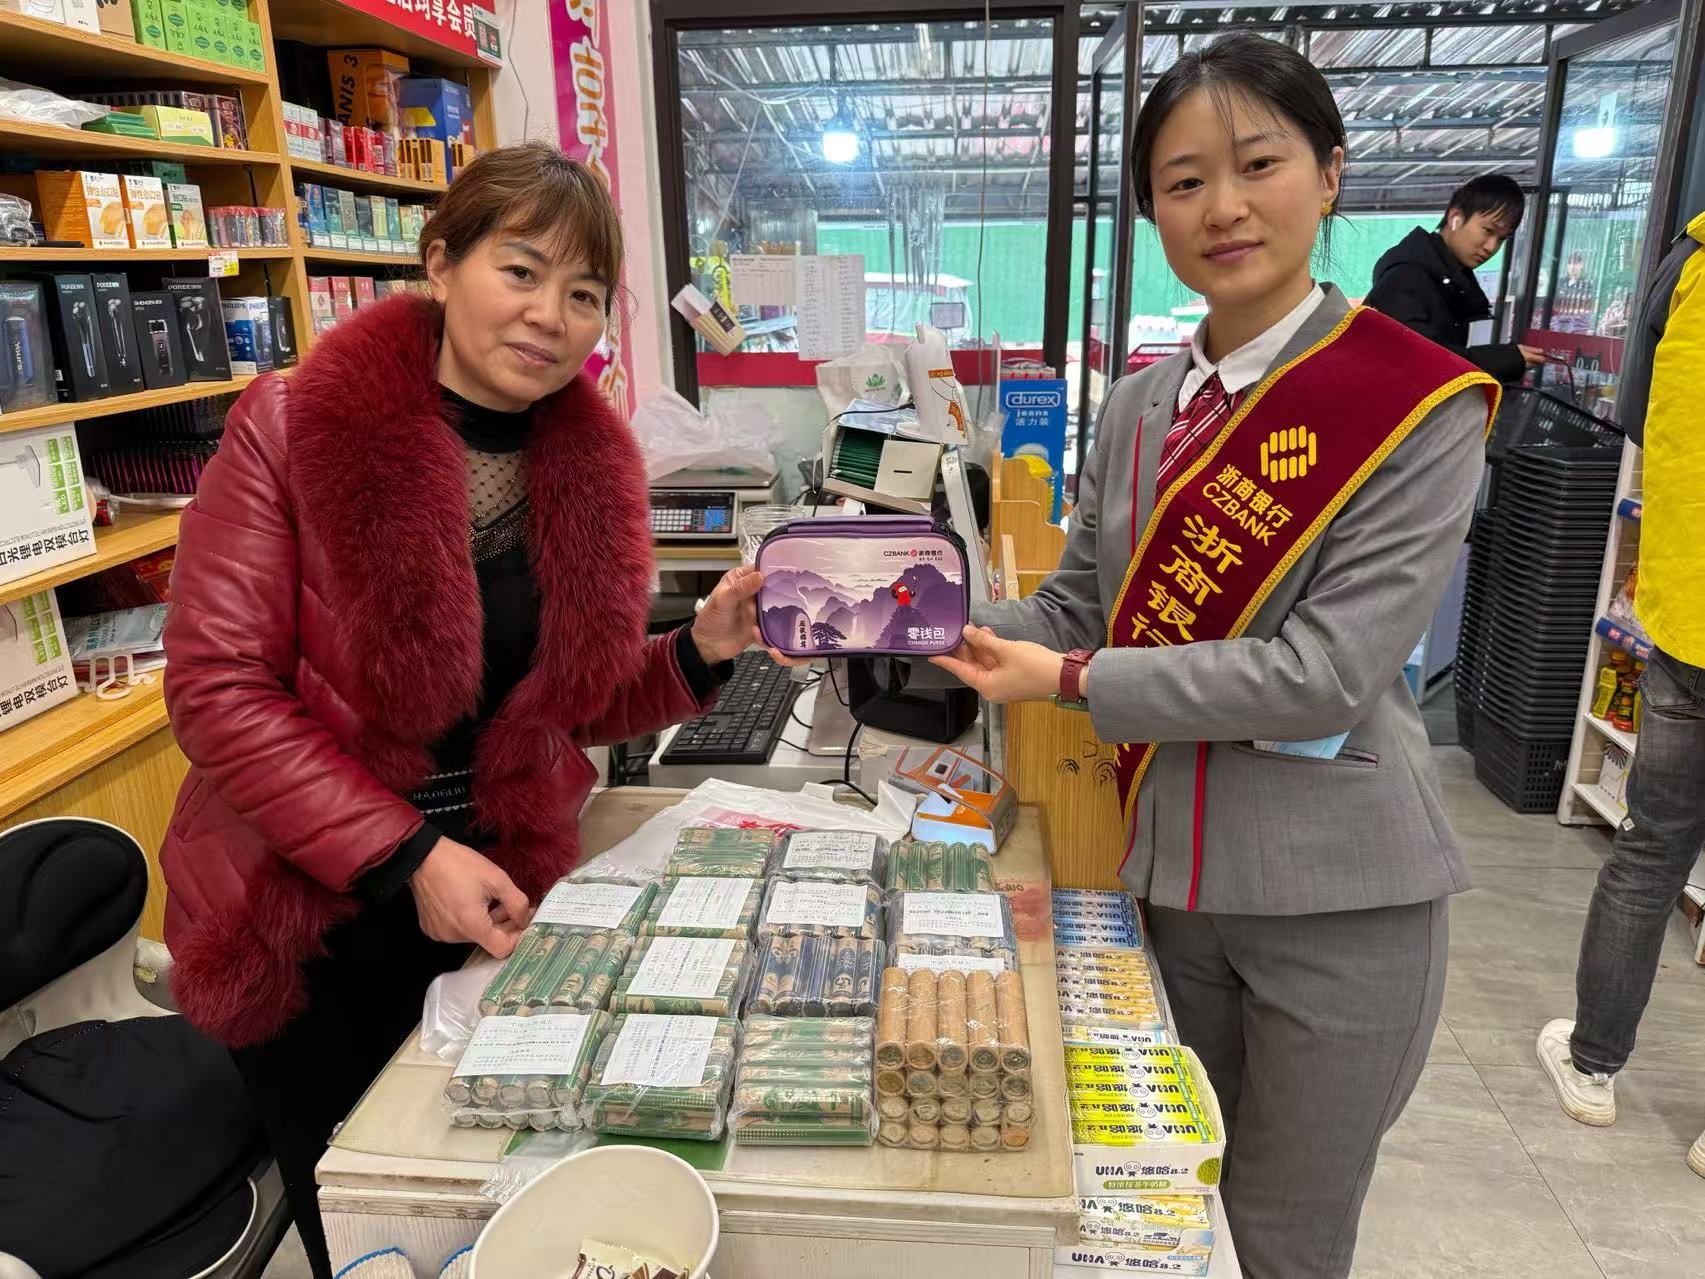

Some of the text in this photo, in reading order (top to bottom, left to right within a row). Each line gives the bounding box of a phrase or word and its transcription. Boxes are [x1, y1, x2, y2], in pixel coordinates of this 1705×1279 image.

[386, 0, 476, 40] 可享会员
[1012, 393, 1057, 406] durex
[1016, 409, 1048, 417] jeans
[1216, 463, 1293, 529] 浙商银行
[1202, 482, 1277, 547] CZBANK
[907, 627, 945, 640] 零钱包
[0, 675, 69, 717] 锂电双模台灯
[1142, 1065, 1174, 1074] UHA
[1146, 1083, 1179, 1093] UHA
[1153, 1103, 1186, 1112] UHA
[1162, 1124, 1197, 1134] UHA
[1095, 1166, 1124, 1175] UHA
[1071, 1252, 1105, 1264] UHA
